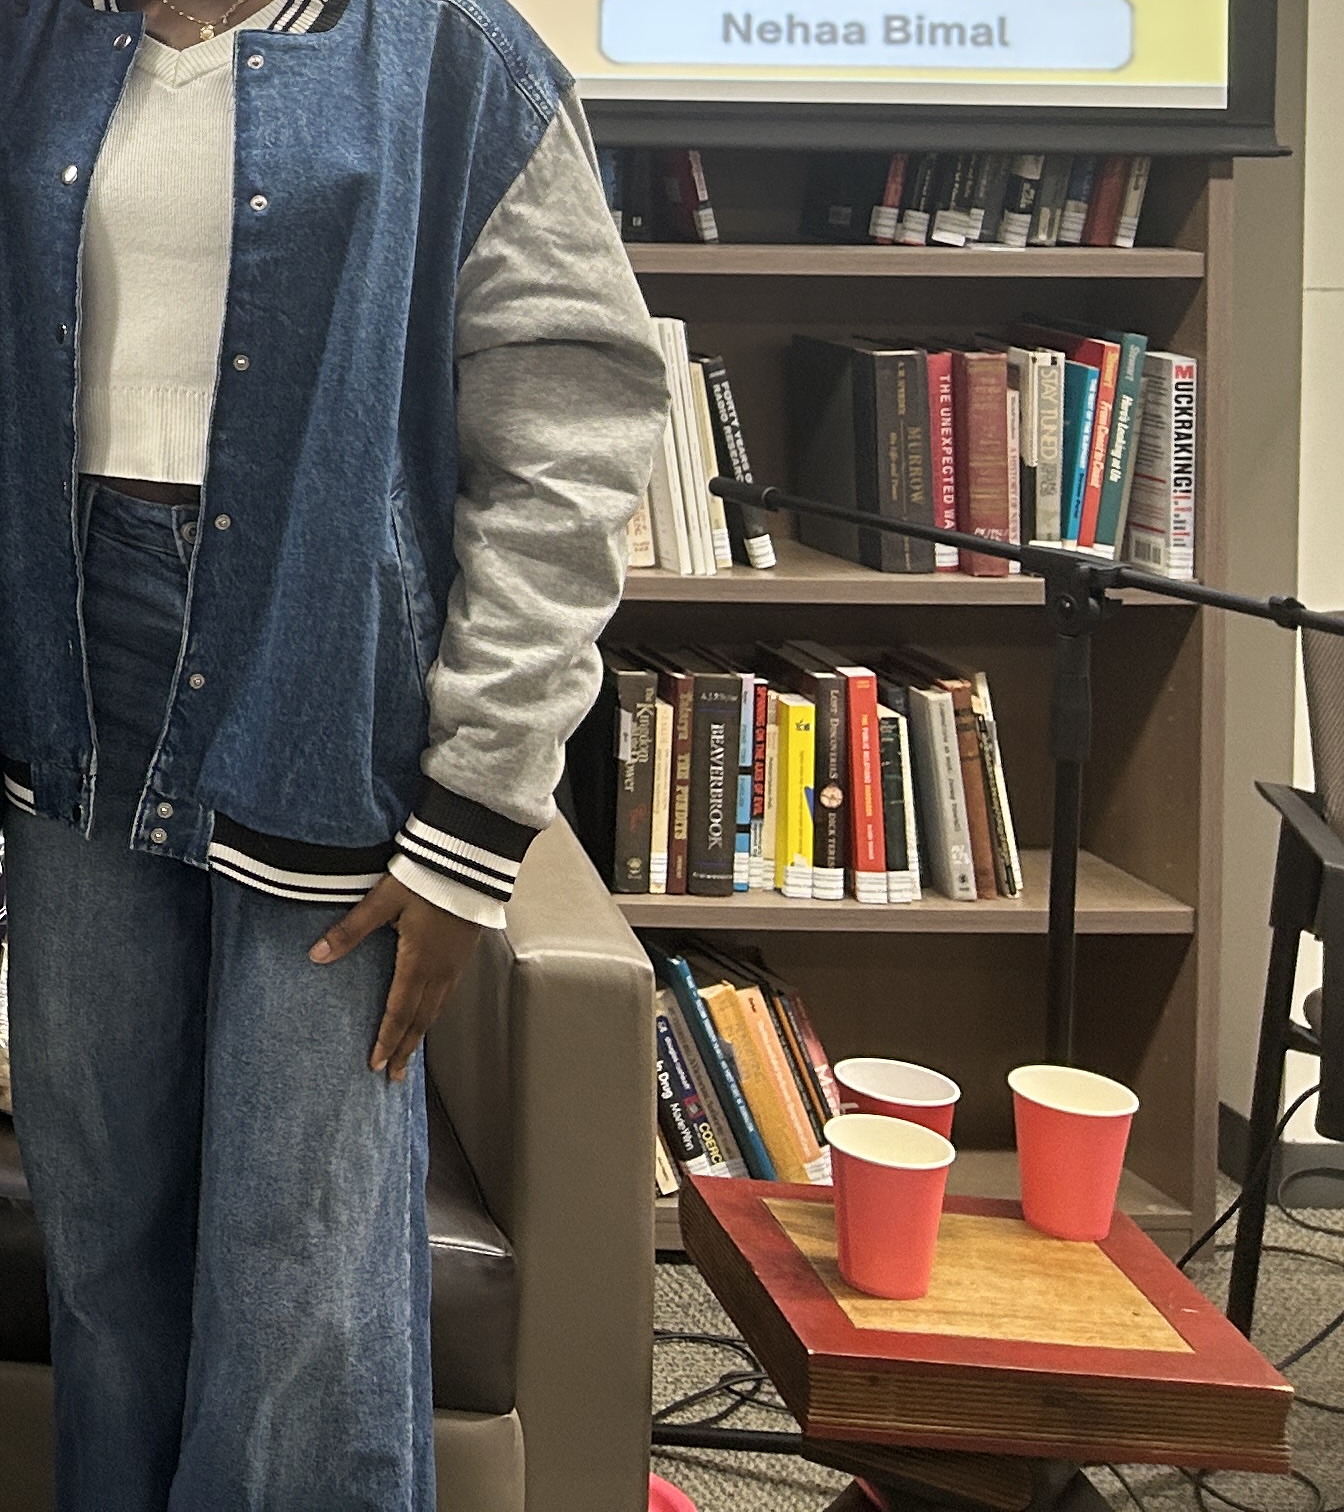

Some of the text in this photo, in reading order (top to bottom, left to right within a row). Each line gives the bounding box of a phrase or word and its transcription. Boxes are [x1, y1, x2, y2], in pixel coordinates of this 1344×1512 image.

[721, 13, 1010, 48] Nehaa Bimal
[1039, 367, 1059, 403] STAY
[711, 382, 744, 484] RADIO RESEARC
[719, 380, 753, 484] FORTY YEARS O
[938, 374, 955, 529] THE UNEXPECTED WA
[1039, 406, 1058, 460] TUNED
[1109, 421, 1129, 459] Looking
[1171, 363, 1195, 494] MUCKRAKING!
[906, 425, 925, 506] MURROW
[635, 702, 654, 764] Kingdom
[754, 743, 765, 760] THE
[676, 752, 689, 779] THE
[707, 722, 725, 851] BEAVERBROOK
[826, 689, 839, 868] LOST DISCOVERIES DICK TERES
[657, 1071, 675, 1100] Drug
[669, 1102, 687, 1131] Marie
[698, 1121, 724, 1165] COERC
